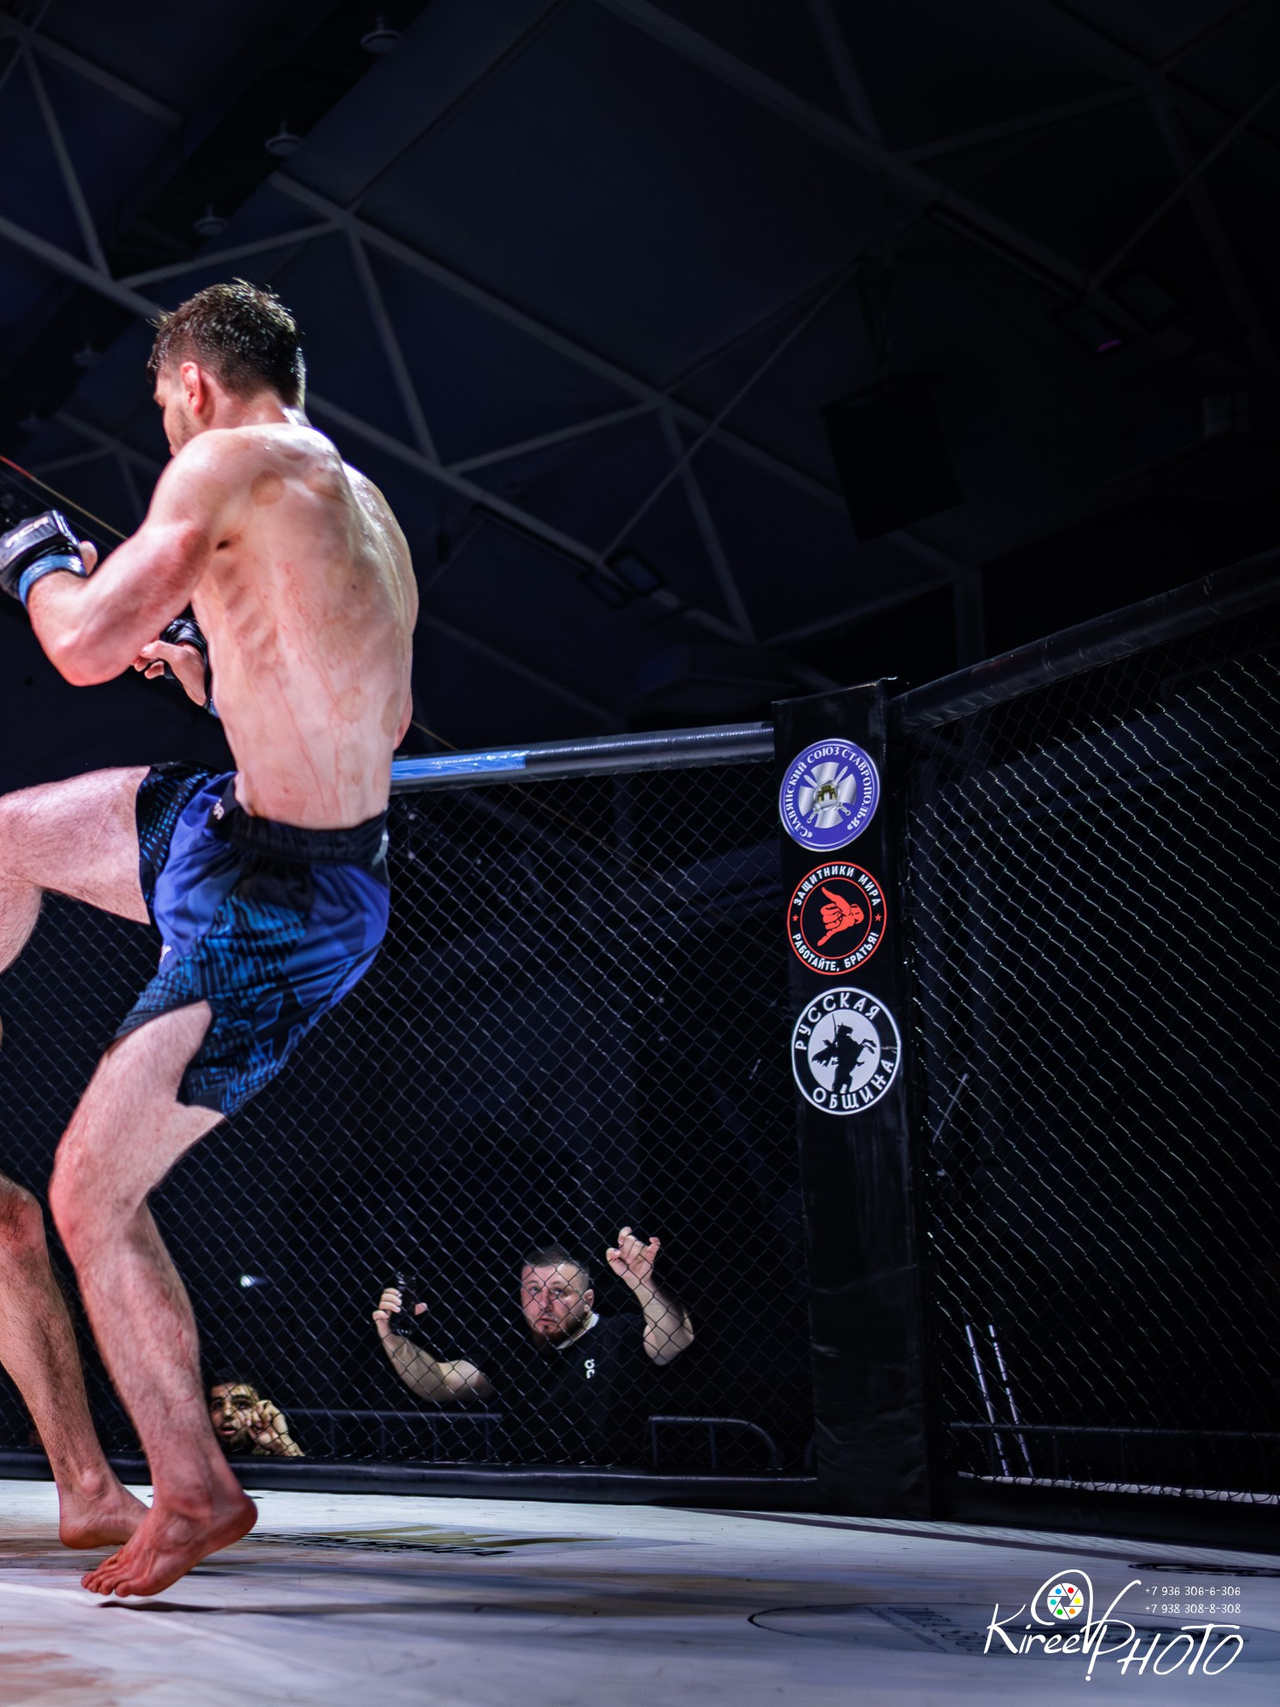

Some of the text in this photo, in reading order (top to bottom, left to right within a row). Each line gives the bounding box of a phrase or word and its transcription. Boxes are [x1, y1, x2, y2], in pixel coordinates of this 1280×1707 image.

[807, 746, 840, 767] СОЮЗ
[793, 865, 882, 907] ЗАЩИТНИКИ МИРА
[843, 931, 880, 970] БРАТЬЯ!
[794, 991, 880, 1052] РУССКАЯ
[812, 1058, 894, 1110] ОБЩИНА
